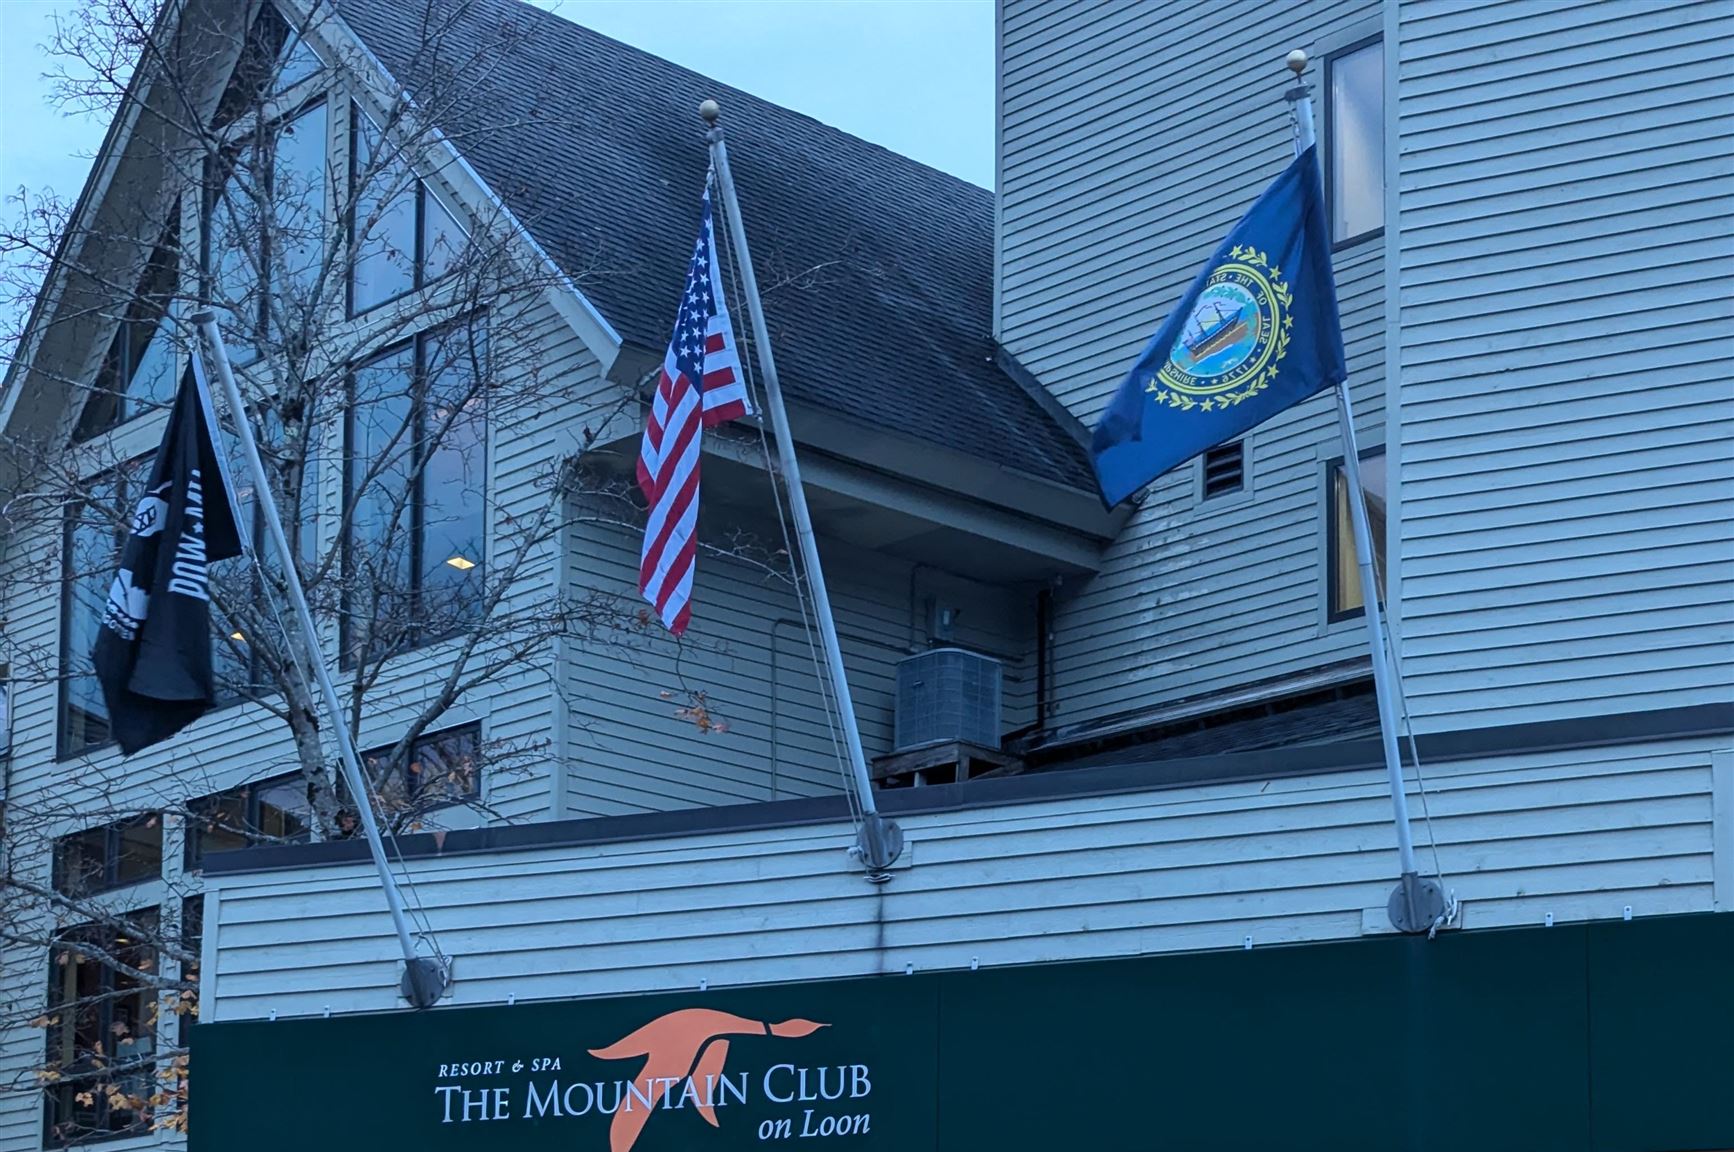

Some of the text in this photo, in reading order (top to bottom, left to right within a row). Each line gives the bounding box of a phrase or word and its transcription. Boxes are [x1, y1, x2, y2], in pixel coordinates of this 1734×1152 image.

[168, 531, 210, 601] POW
[438, 1057, 562, 1078] RESORT & SPA
[434, 1063, 872, 1123] THE MOUNTAIN CLUB
[758, 1109, 871, 1140] on Loon
